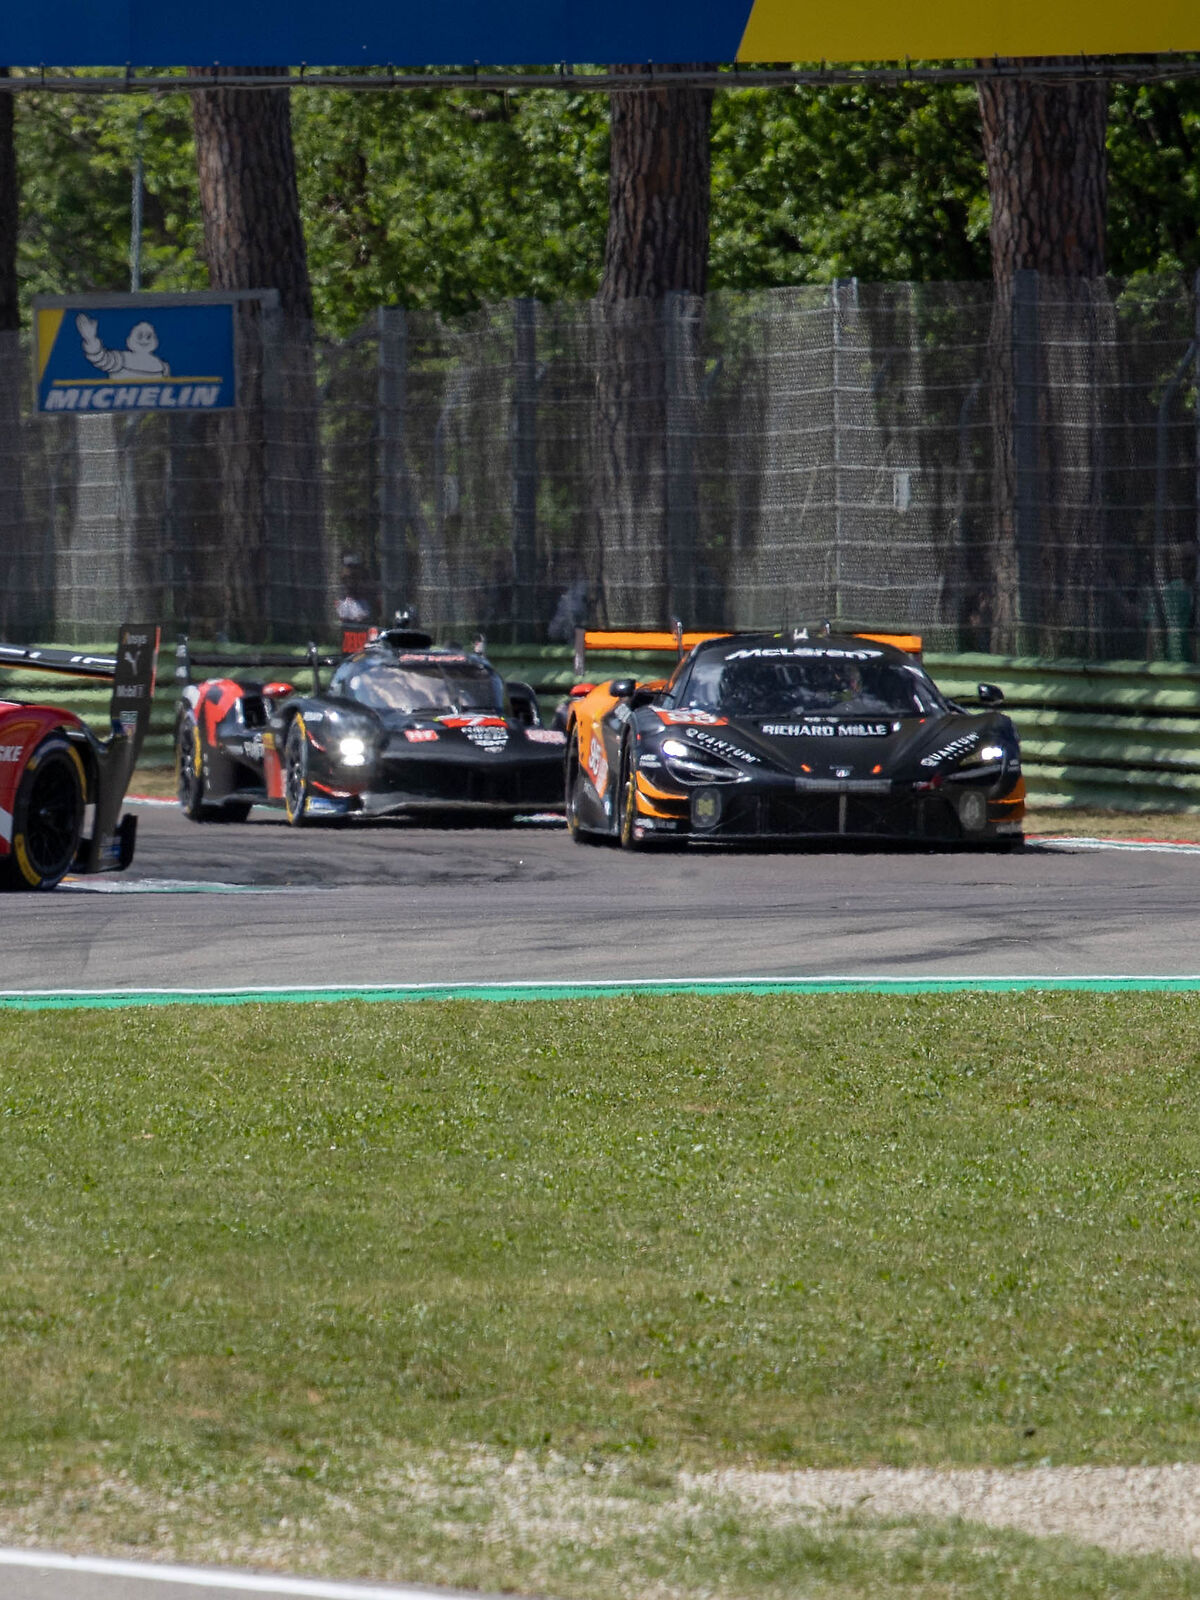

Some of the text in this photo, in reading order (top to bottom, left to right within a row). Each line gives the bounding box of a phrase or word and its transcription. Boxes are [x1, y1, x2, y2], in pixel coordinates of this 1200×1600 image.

[45, 386, 220, 410] MICHELIN
[725, 648, 884, 660] McLaren
[762, 724, 887, 737] RICHARD MILLE
